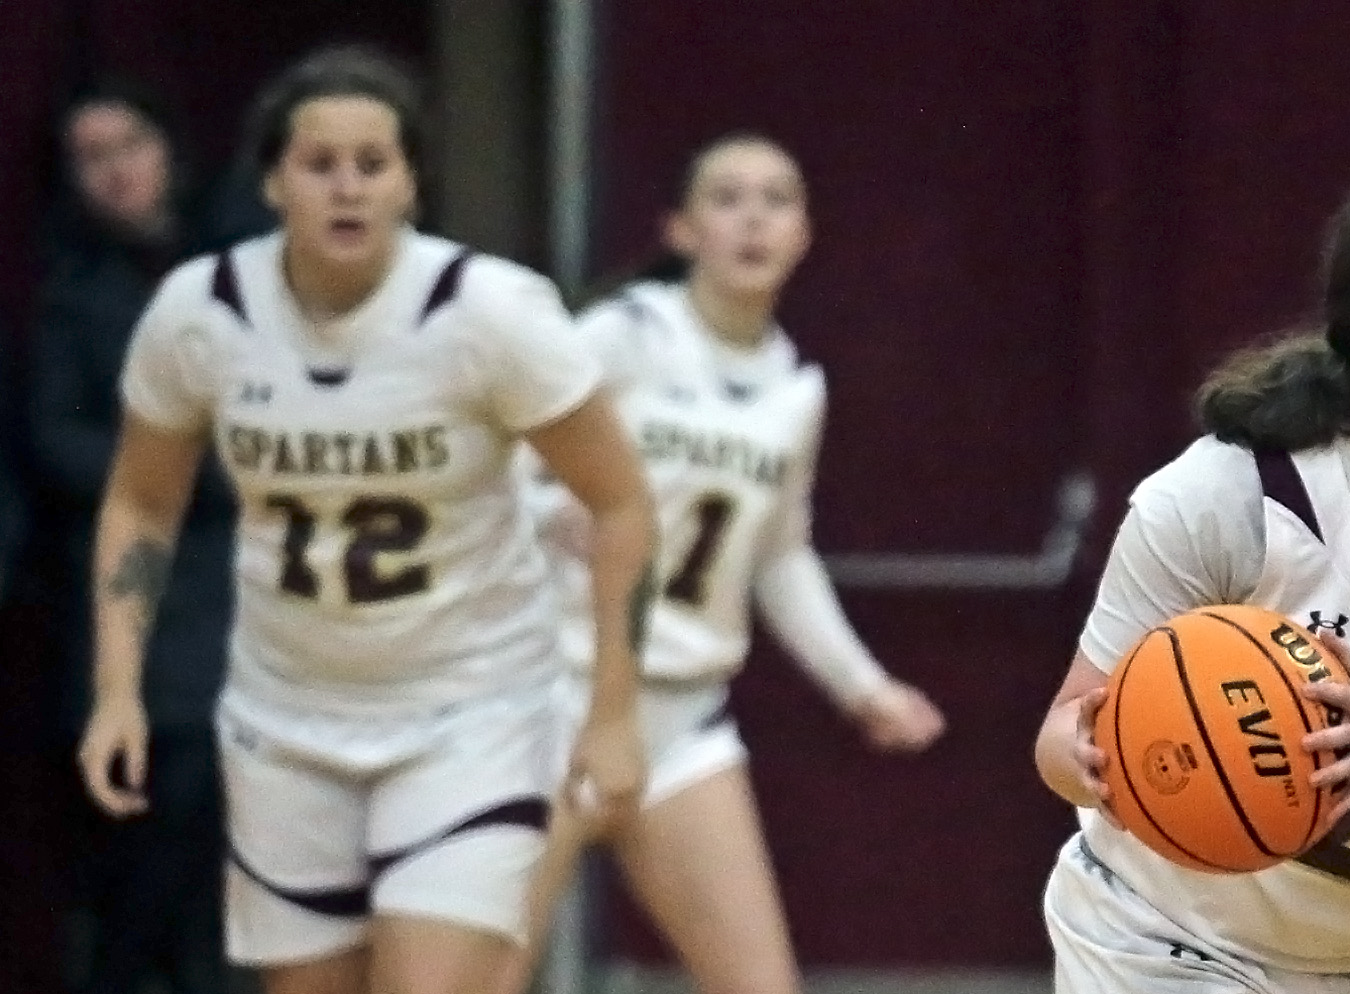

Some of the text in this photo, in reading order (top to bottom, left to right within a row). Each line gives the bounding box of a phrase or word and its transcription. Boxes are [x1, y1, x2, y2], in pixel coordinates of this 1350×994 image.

[229, 426, 450, 475] SPARTANS
[265, 494, 431, 603] 12
[1221, 680, 1292, 778] EVO
